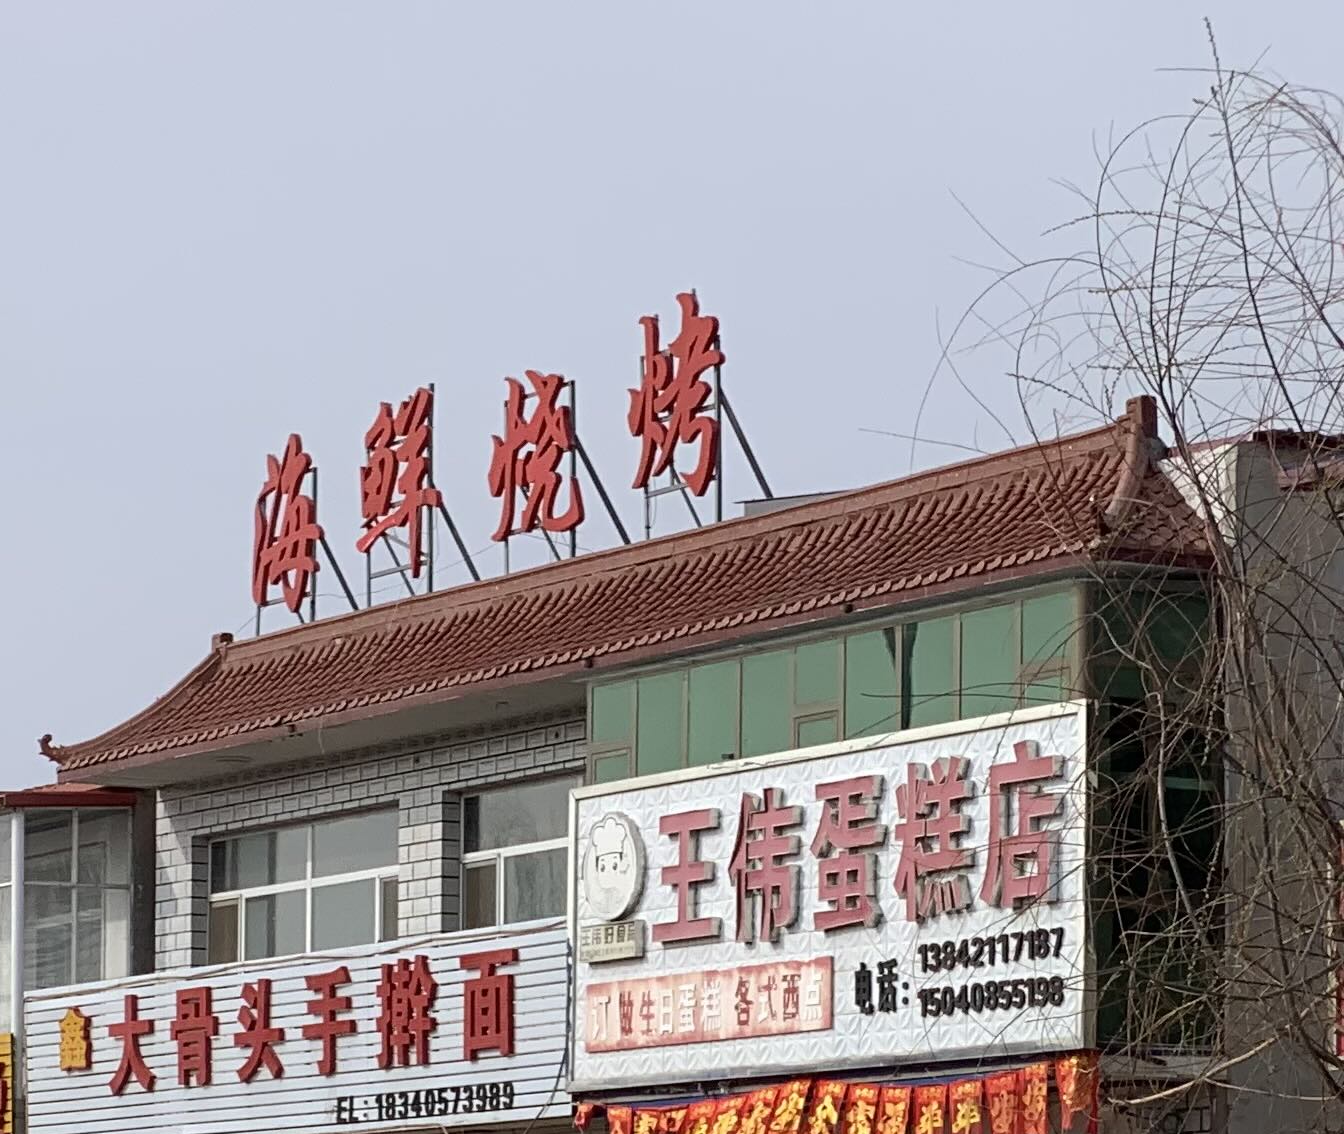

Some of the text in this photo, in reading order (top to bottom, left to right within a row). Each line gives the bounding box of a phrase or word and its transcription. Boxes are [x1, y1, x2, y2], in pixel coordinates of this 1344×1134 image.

[252, 292, 725, 613] 海鲜烧烤
[652, 740, 1065, 945] 王伟蛋糕店
[109, 948, 520, 1096] 大骨头手擀面
[917, 975, 1064, 1018] 15040855198
[918, 926, 1065, 973] 13842117187
